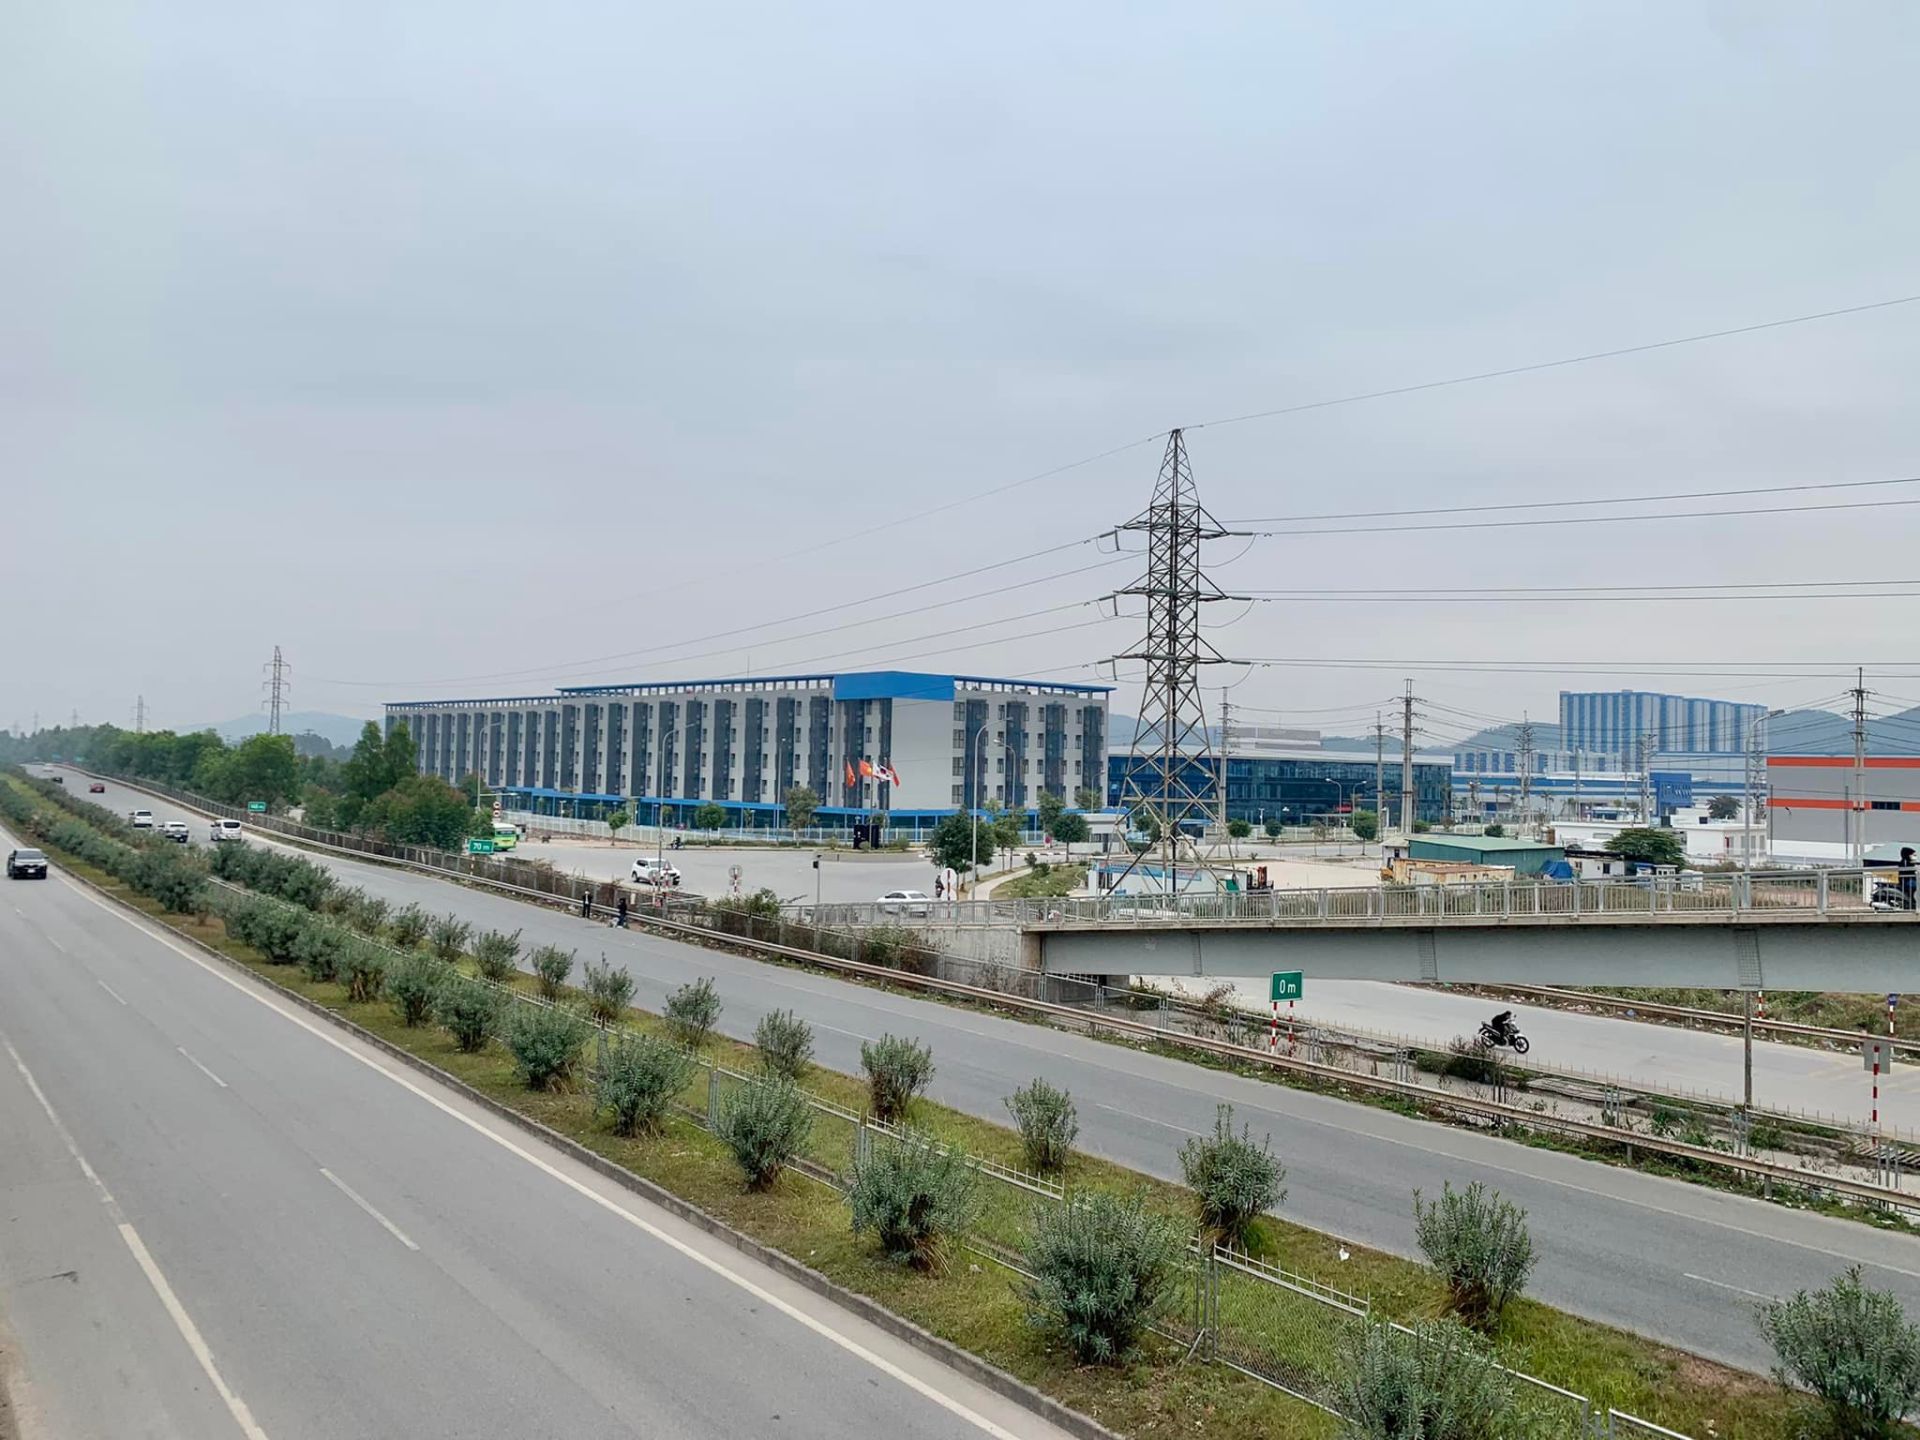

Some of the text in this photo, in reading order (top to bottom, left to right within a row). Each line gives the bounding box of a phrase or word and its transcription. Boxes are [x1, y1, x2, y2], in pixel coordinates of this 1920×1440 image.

[472, 842, 482, 850] 70
[1279, 979, 1296, 994] 0 m
